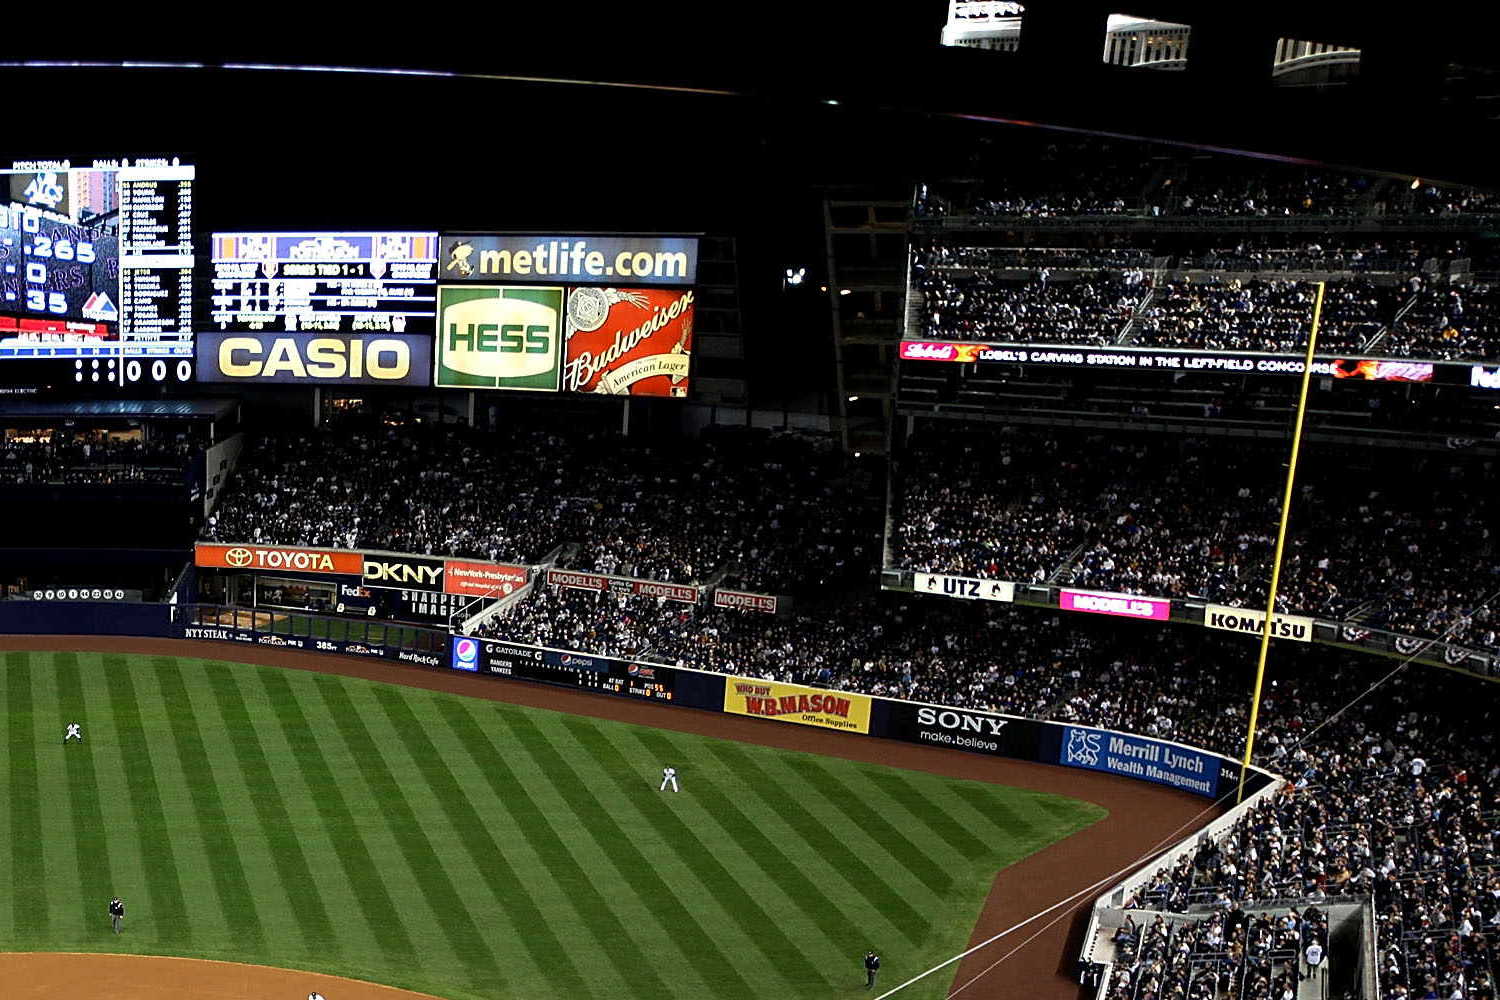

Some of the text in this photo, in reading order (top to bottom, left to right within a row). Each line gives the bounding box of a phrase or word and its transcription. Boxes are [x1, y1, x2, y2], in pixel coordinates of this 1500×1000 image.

[24, 236, 96, 264] .265
[480, 241, 687, 278] metlife.com
[26, 262, 47, 284] 0
[26, 289, 68, 314] 35
[448, 323, 550, 355] HESS
[565, 290, 694, 391] Budweiser
[218, 337, 411, 380] CASIO
[980, 350, 1339, 375] LOBEL'S CARVING STATION IN THE LEFT-FIELD CONCORSE
[127, 360, 141, 382] 0
[152, 360, 166, 381] 0
[176, 360, 191, 381] 0
[613, 361, 655, 389] American
[658, 361, 686, 372] Lager
[256, 550, 334, 571] TOYOTA
[364, 562, 443, 585] DKNY
[552, 573, 603, 588] MODELL'S
[341, 584, 371, 598] FedEx
[639, 585, 692, 599] MODELL'S
[943, 579, 981, 597] UTZ
[402, 591, 466, 606] SHARPER
[717, 593, 774, 609] MODELL'S
[1073, 596, 1153, 617] MODELL'S
[412, 602, 457, 617] IMAGE
[185, 628, 203, 638] NYY
[203, 629, 227, 639] STEAK
[399, 652, 439, 665] Hard Rock Cafe
[496, 647, 532, 658] GATORADE
[571, 657, 592, 667] pepsi
[489, 659, 512, 668] RANGERS
[491, 666, 511, 675] YANKEES
[736, 685, 771, 696] WHO BUT
[802, 714, 857, 729] Office Supplies
[918, 708, 1008, 735] SONY
[920, 730, 997, 750] make.believe
[1109, 737, 1203, 773] Merrill Lynch
[1107, 757, 1210, 792] Wealth Management
